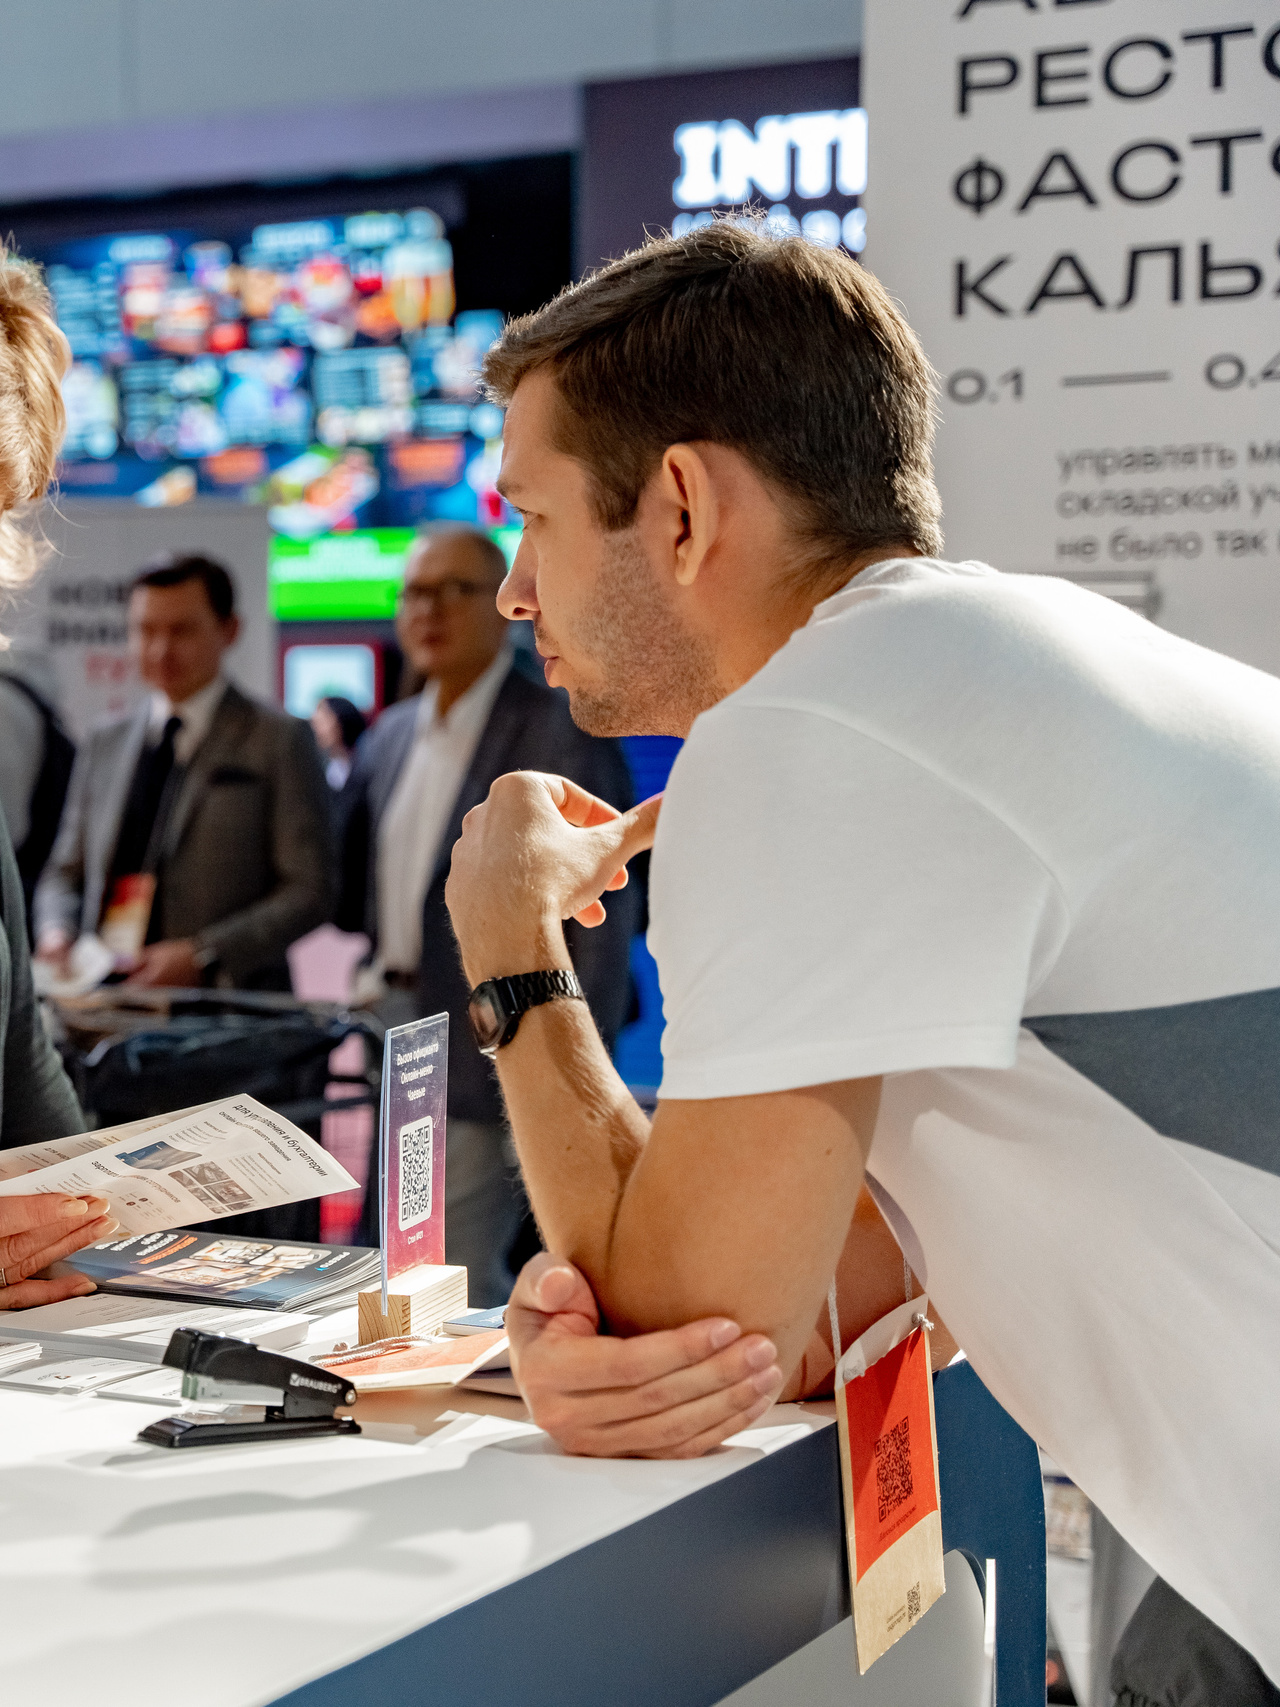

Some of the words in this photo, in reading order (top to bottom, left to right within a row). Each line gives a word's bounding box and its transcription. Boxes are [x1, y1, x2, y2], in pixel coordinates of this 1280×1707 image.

[958, 23, 1280, 115] РЕСТ
[953, 131, 1280, 215] ФАСТ
[955, 241, 1280, 318] КАЛЬ
[947, 367, 1023, 405] 0.1
[1057, 443, 1237, 483] управлять
[1056, 482, 1240, 519] складской
[1056, 536, 1100, 563] не
[1108, 527, 1203, 562] было
[1214, 529, 1268, 558] так
[396, 1052, 414, 1067] Вызов
[407, 1087, 426, 1102] Чаевые
[232, 1104, 251, 1116] для
[282, 1132, 291, 1140] и
[287, 1139, 328, 1177] бухгалтерии
[268, 1139, 292, 1161] заведения
